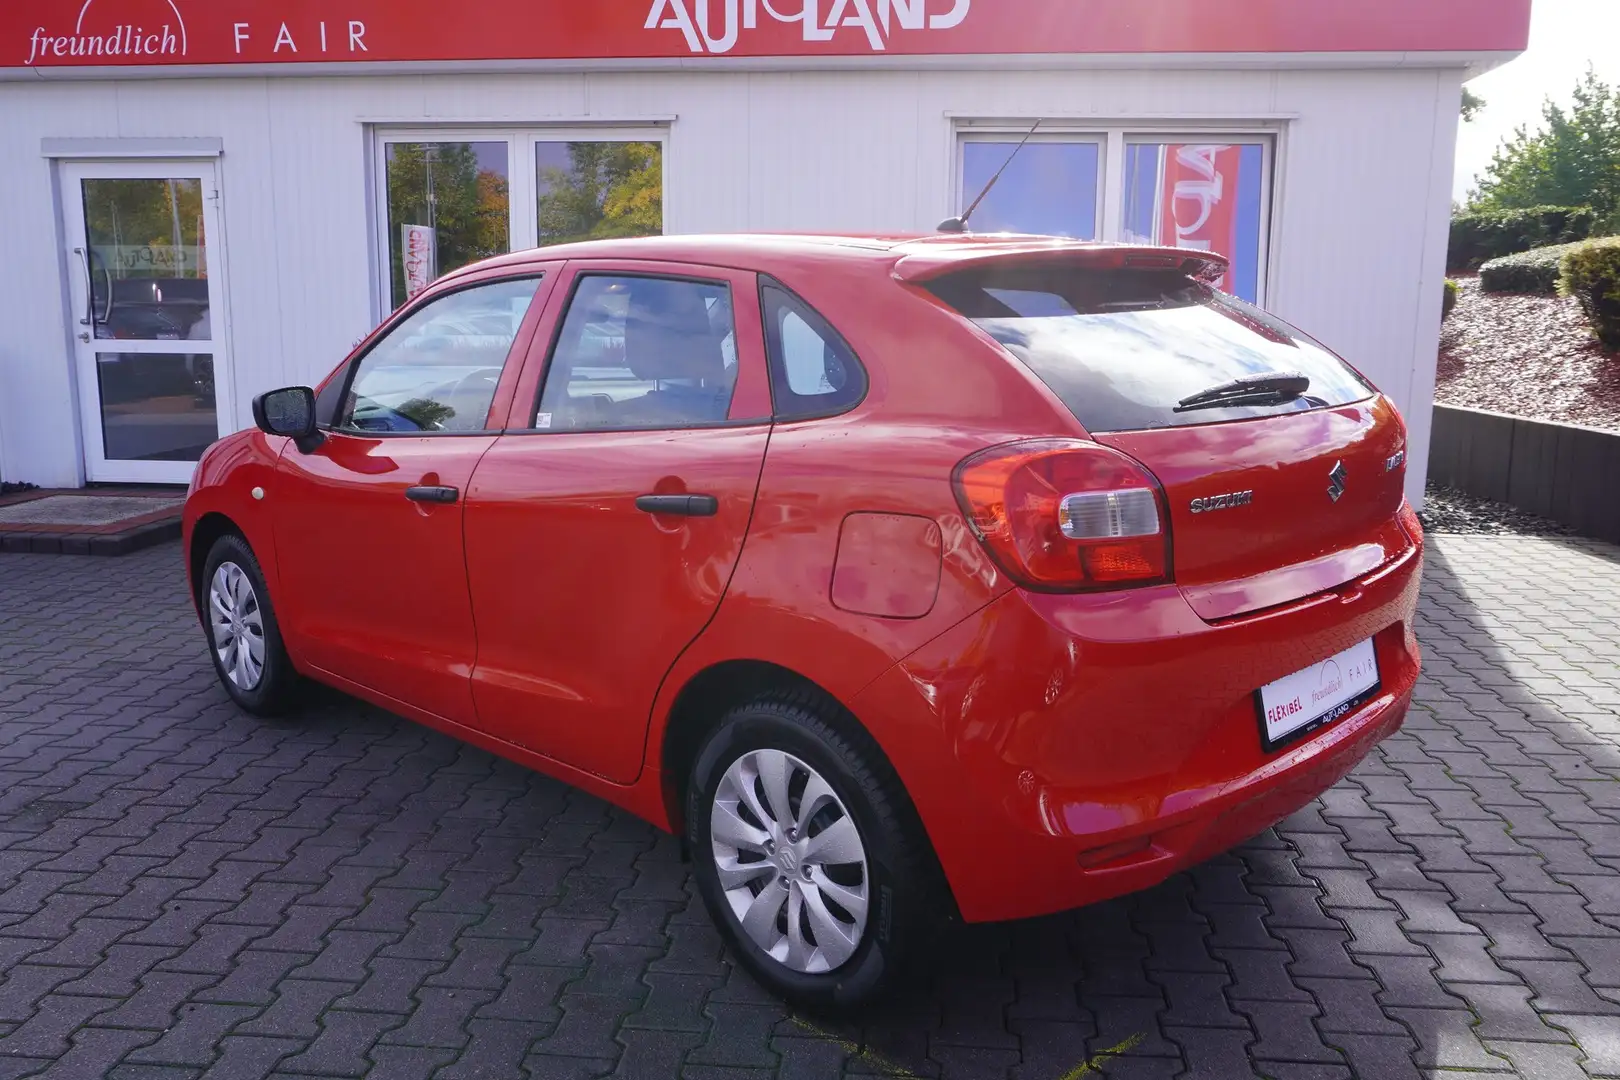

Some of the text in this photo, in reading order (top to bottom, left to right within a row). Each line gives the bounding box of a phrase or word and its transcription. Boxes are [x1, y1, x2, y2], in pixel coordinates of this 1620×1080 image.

[24, 20, 368, 64] freundlich FAIR
[1190, 489, 1253, 513] SUZUKI
[1267, 696, 1303, 725] FLEXIBEL
[1348, 658, 1374, 682] FAIR
